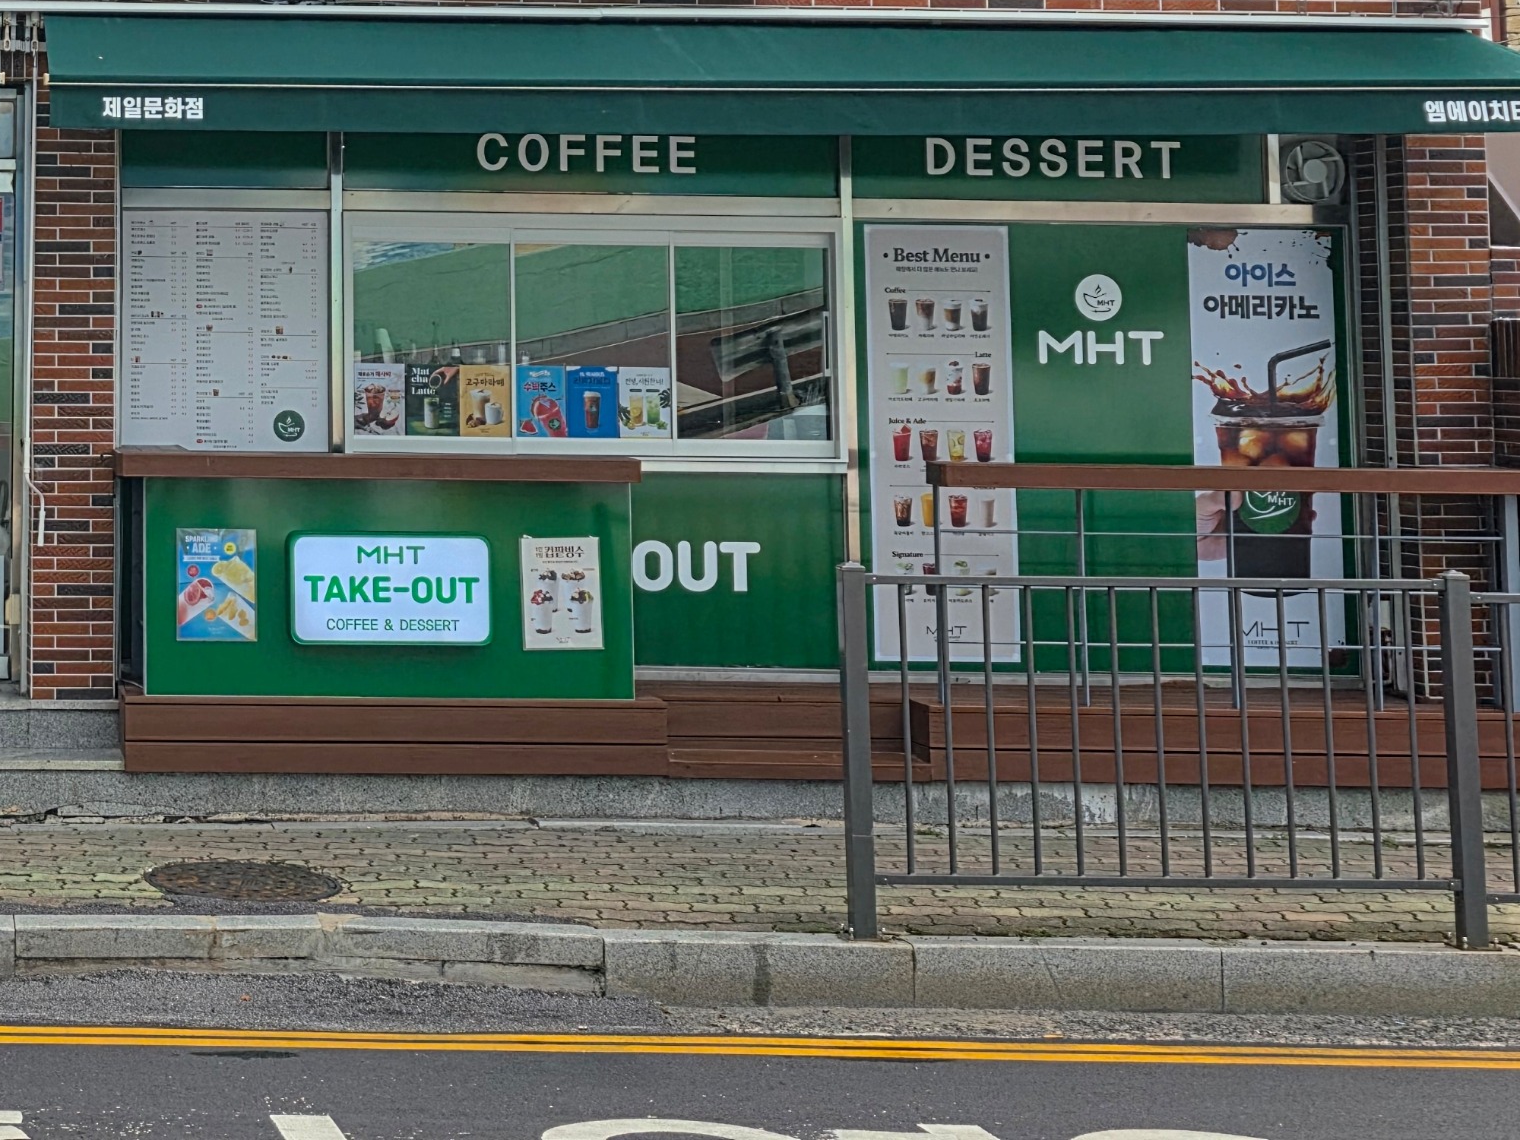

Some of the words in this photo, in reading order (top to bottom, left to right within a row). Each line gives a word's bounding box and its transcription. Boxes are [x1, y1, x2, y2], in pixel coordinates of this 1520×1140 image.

[101, 96, 205, 120] 제일문화점
[476, 132, 697, 174] COFFEE
[925, 137, 1182, 180] DESSERT
[893, 247, 930, 262] Best
[932, 248, 981, 263] Menu
[1224, 262, 1297, 288] 아이스
[1096, 299, 1116, 307] MHT
[1202, 295, 1321, 321] 아메리카노
[1038, 330, 1165, 366] MHT
[411, 386, 436, 395] Latte
[465, 377, 505, 387] 고구마라떼
[1267, 494, 1294, 506] MHT
[192, 543, 212, 553] ADE
[357, 545, 425, 565] MHT
[891, 550, 924, 559] Signature
[632, 540, 761, 593] OUT
[303, 575, 480, 604] TAKE-OUT
[326, 618, 379, 631] COFFEE
[384, 618, 394, 631] &
[400, 619, 460, 632] DESSERT
